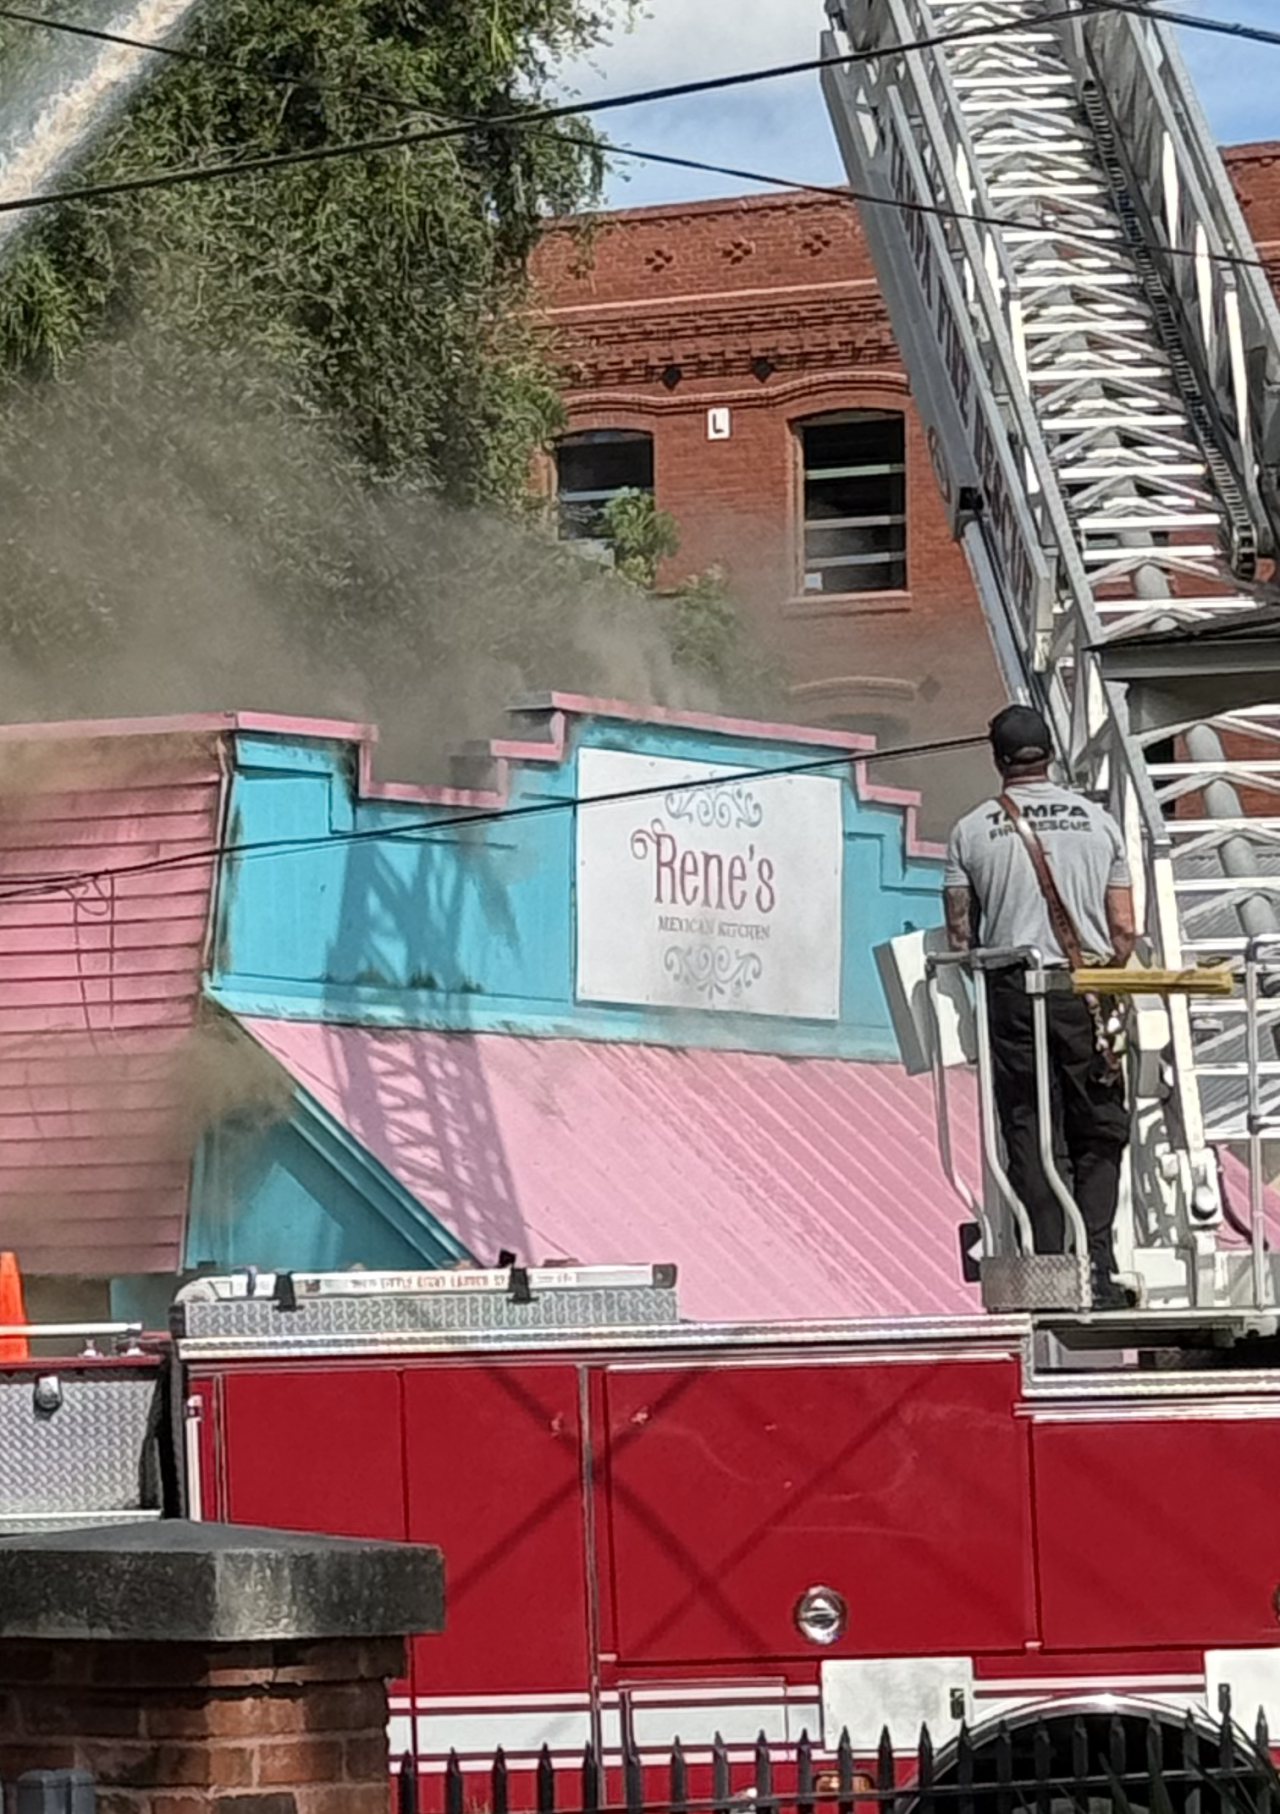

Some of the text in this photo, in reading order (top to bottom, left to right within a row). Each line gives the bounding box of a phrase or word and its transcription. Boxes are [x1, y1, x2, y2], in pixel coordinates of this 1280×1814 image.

[631, 818, 775, 914] Rene's
[658, 915, 771, 941] MEXICAN KITCHEN
